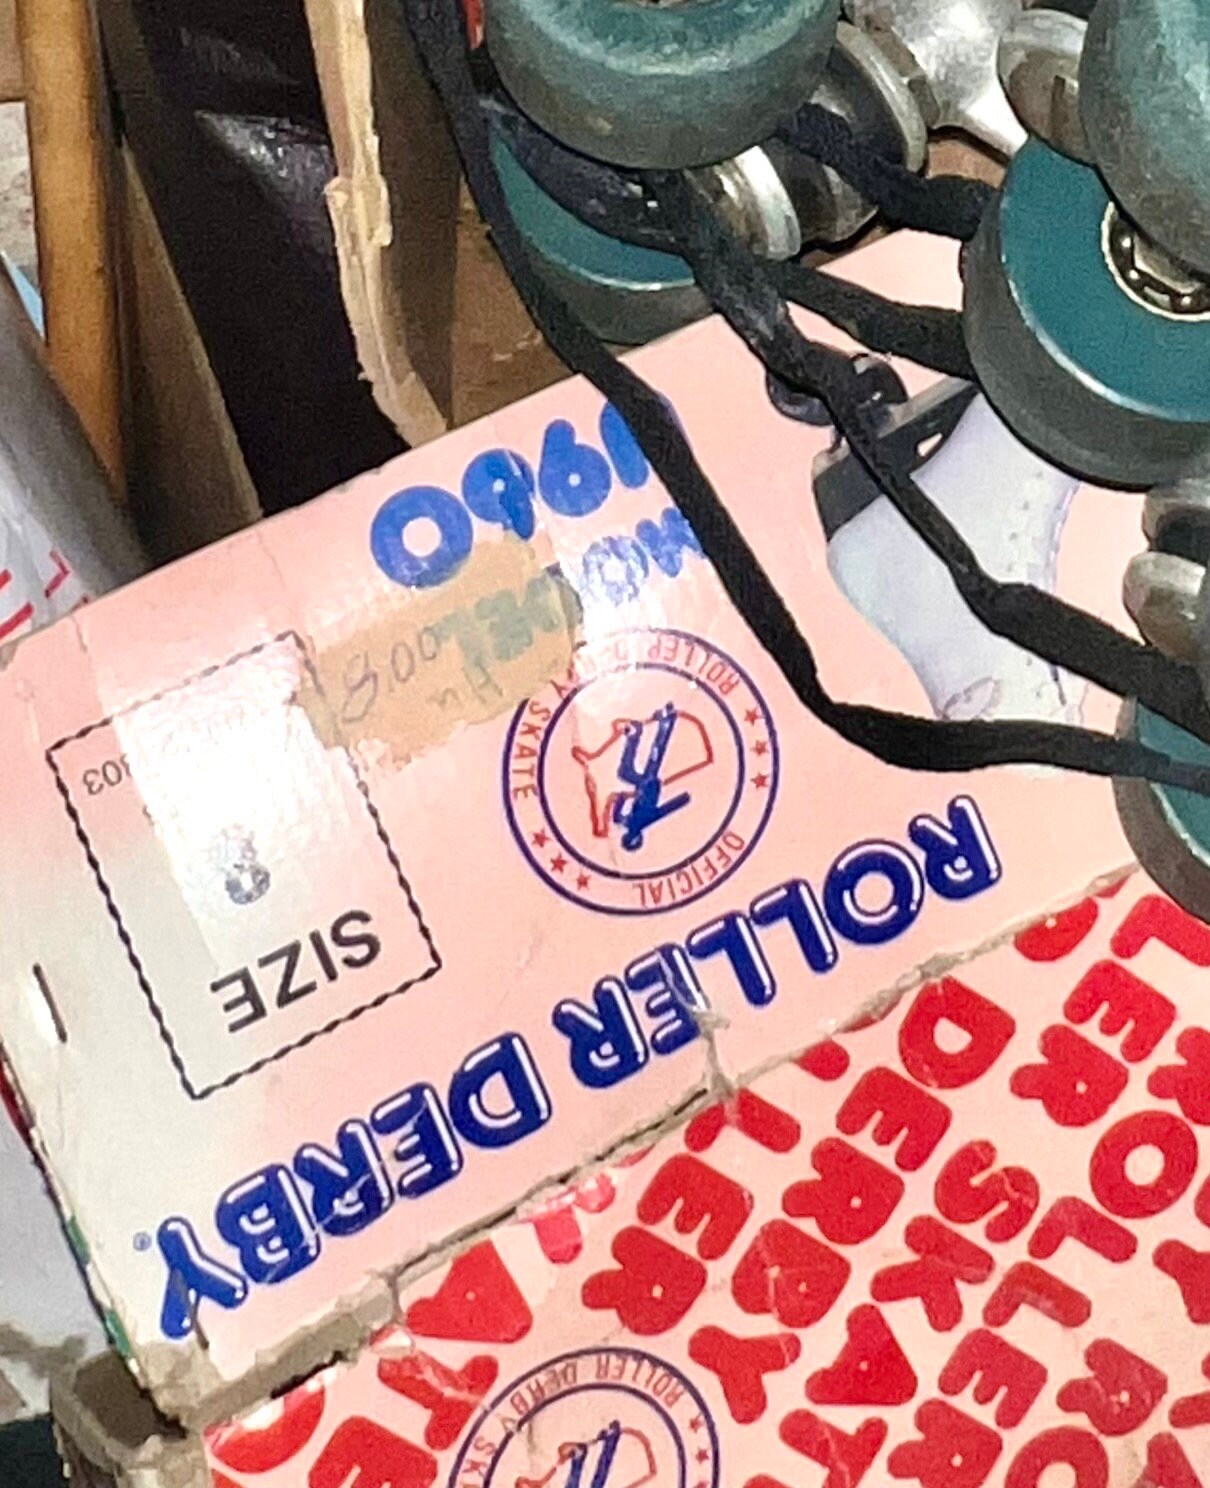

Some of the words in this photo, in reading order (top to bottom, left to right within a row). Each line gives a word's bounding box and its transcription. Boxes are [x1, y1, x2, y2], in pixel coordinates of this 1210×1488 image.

[512, 699, 552, 800] SKATE
[632, 830, 745, 907] OFFICIAL
[210, 910, 381, 1034] SIZE
[552, 794, 1001, 1089] ROLLER
[688, 977, 1016, 1425] DERBY
[745, 1140, 1040, 1488] SKAT
[501, 1362, 577, 1433] DERBY
[596, 1354, 685, 1408] ROLLER
